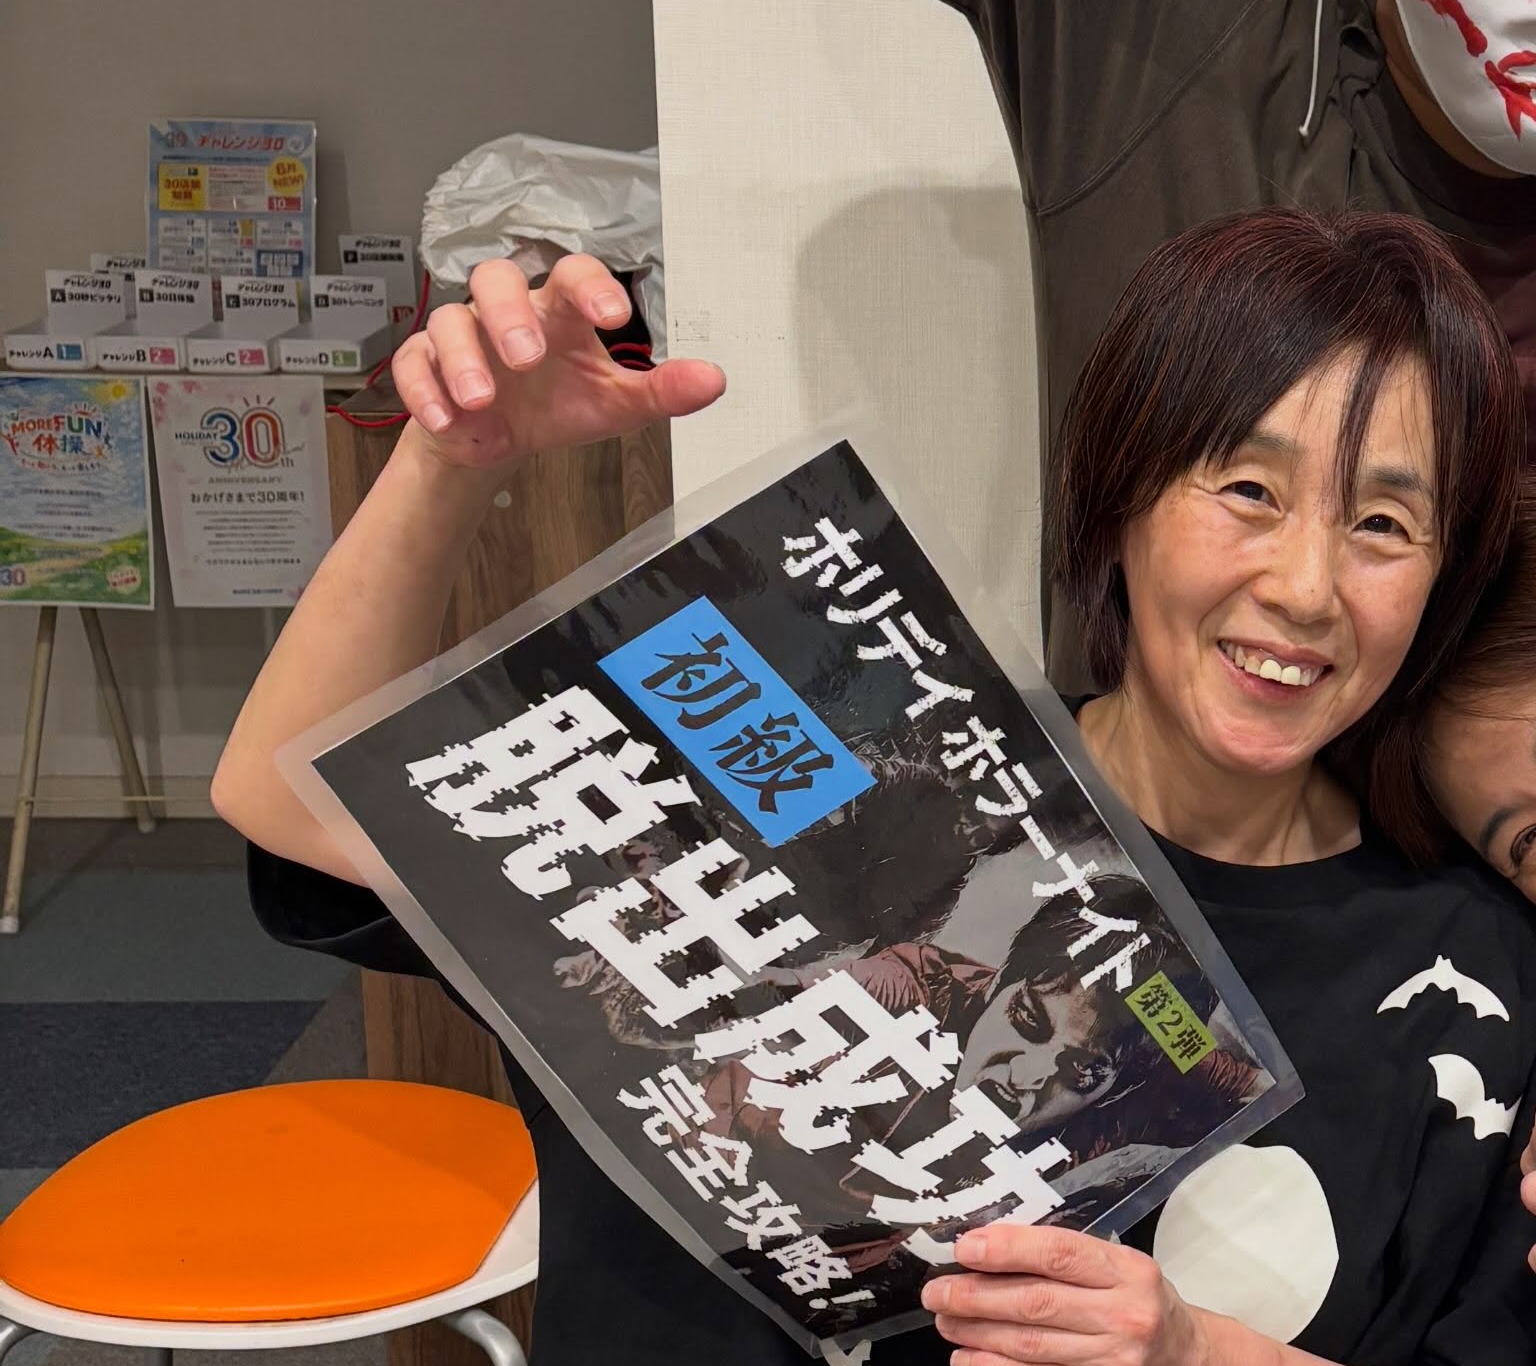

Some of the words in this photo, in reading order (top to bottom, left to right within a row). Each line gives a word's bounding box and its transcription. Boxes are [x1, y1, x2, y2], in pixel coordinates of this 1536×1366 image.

[175, 432, 219, 442] HOLIDAY
[200, 405, 286, 468] 30
[641, 631, 835, 815] 初級
[781, 517, 1150, 992] ホリデイホラーナイト
[406, 687, 1073, 1266] 脱出成功
[1133, 980, 1206, 1061] 第2弾
[615, 1063, 876, 1312] 完全攻略!
